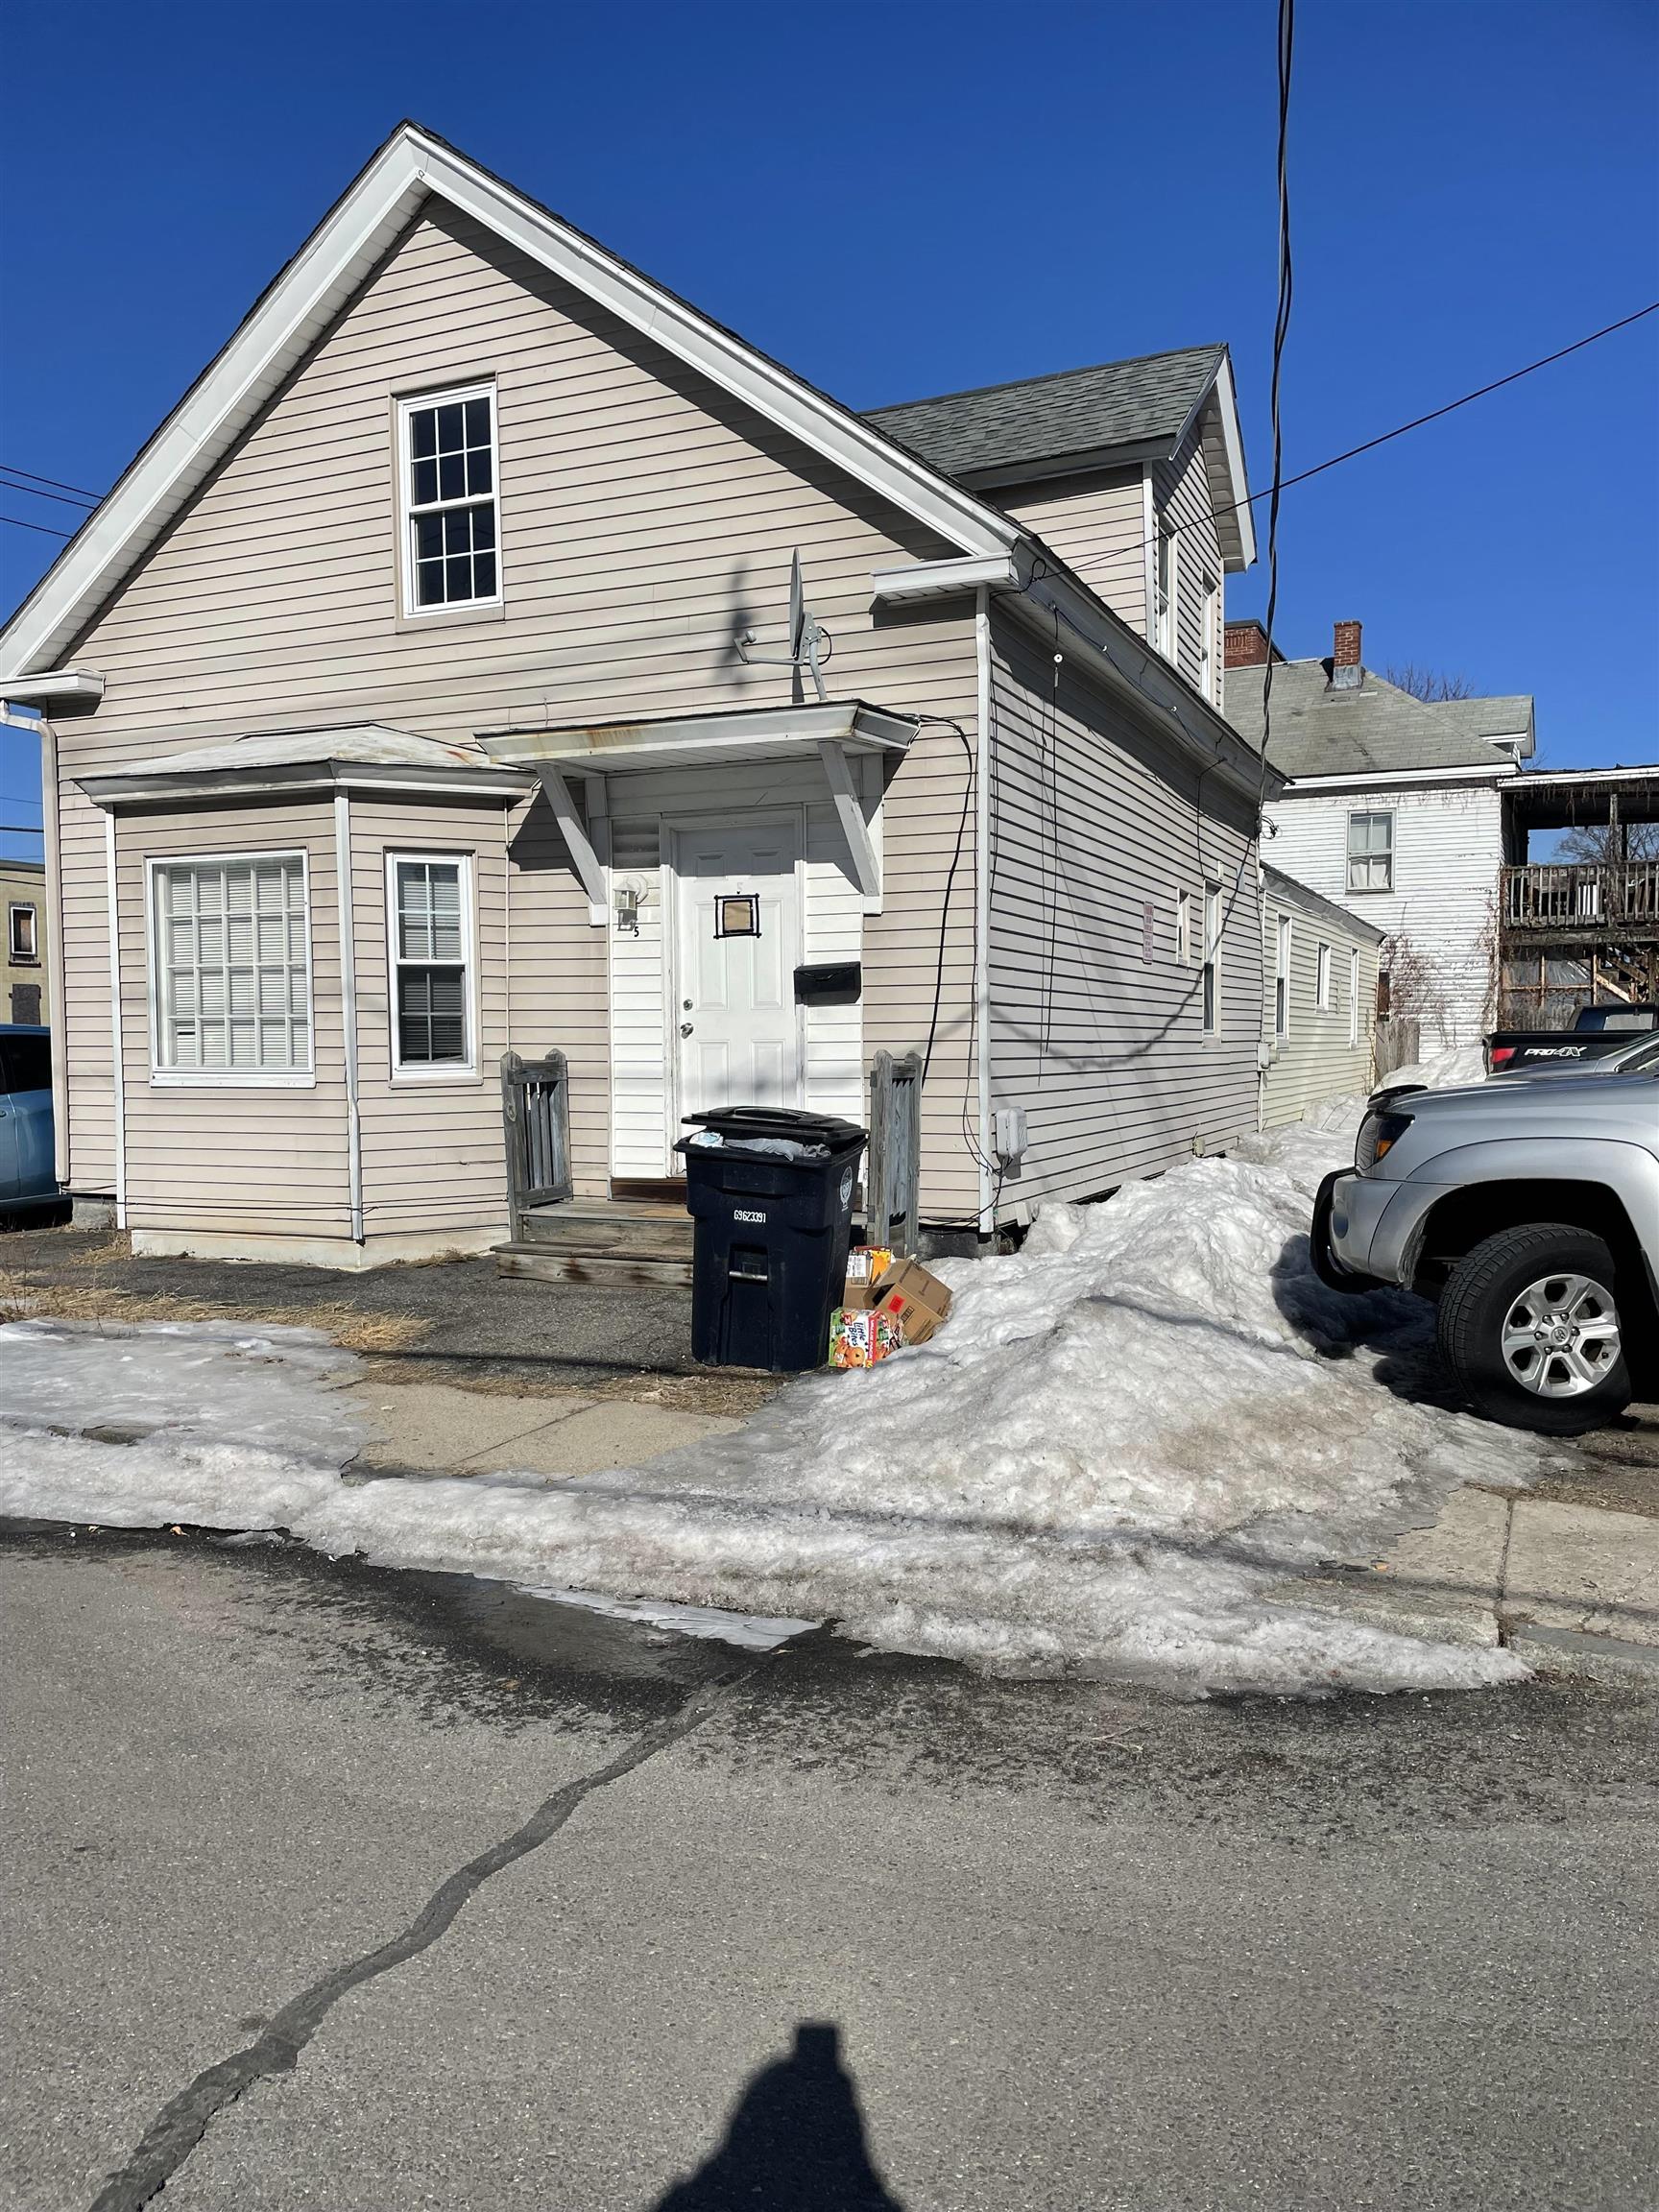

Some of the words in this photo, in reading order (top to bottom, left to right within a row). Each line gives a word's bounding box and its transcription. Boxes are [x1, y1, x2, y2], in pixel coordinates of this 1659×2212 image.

[634, 926, 639, 937] 5
[849, 1327, 858, 1346] Bites
[854, 1322, 866, 1341] Little
